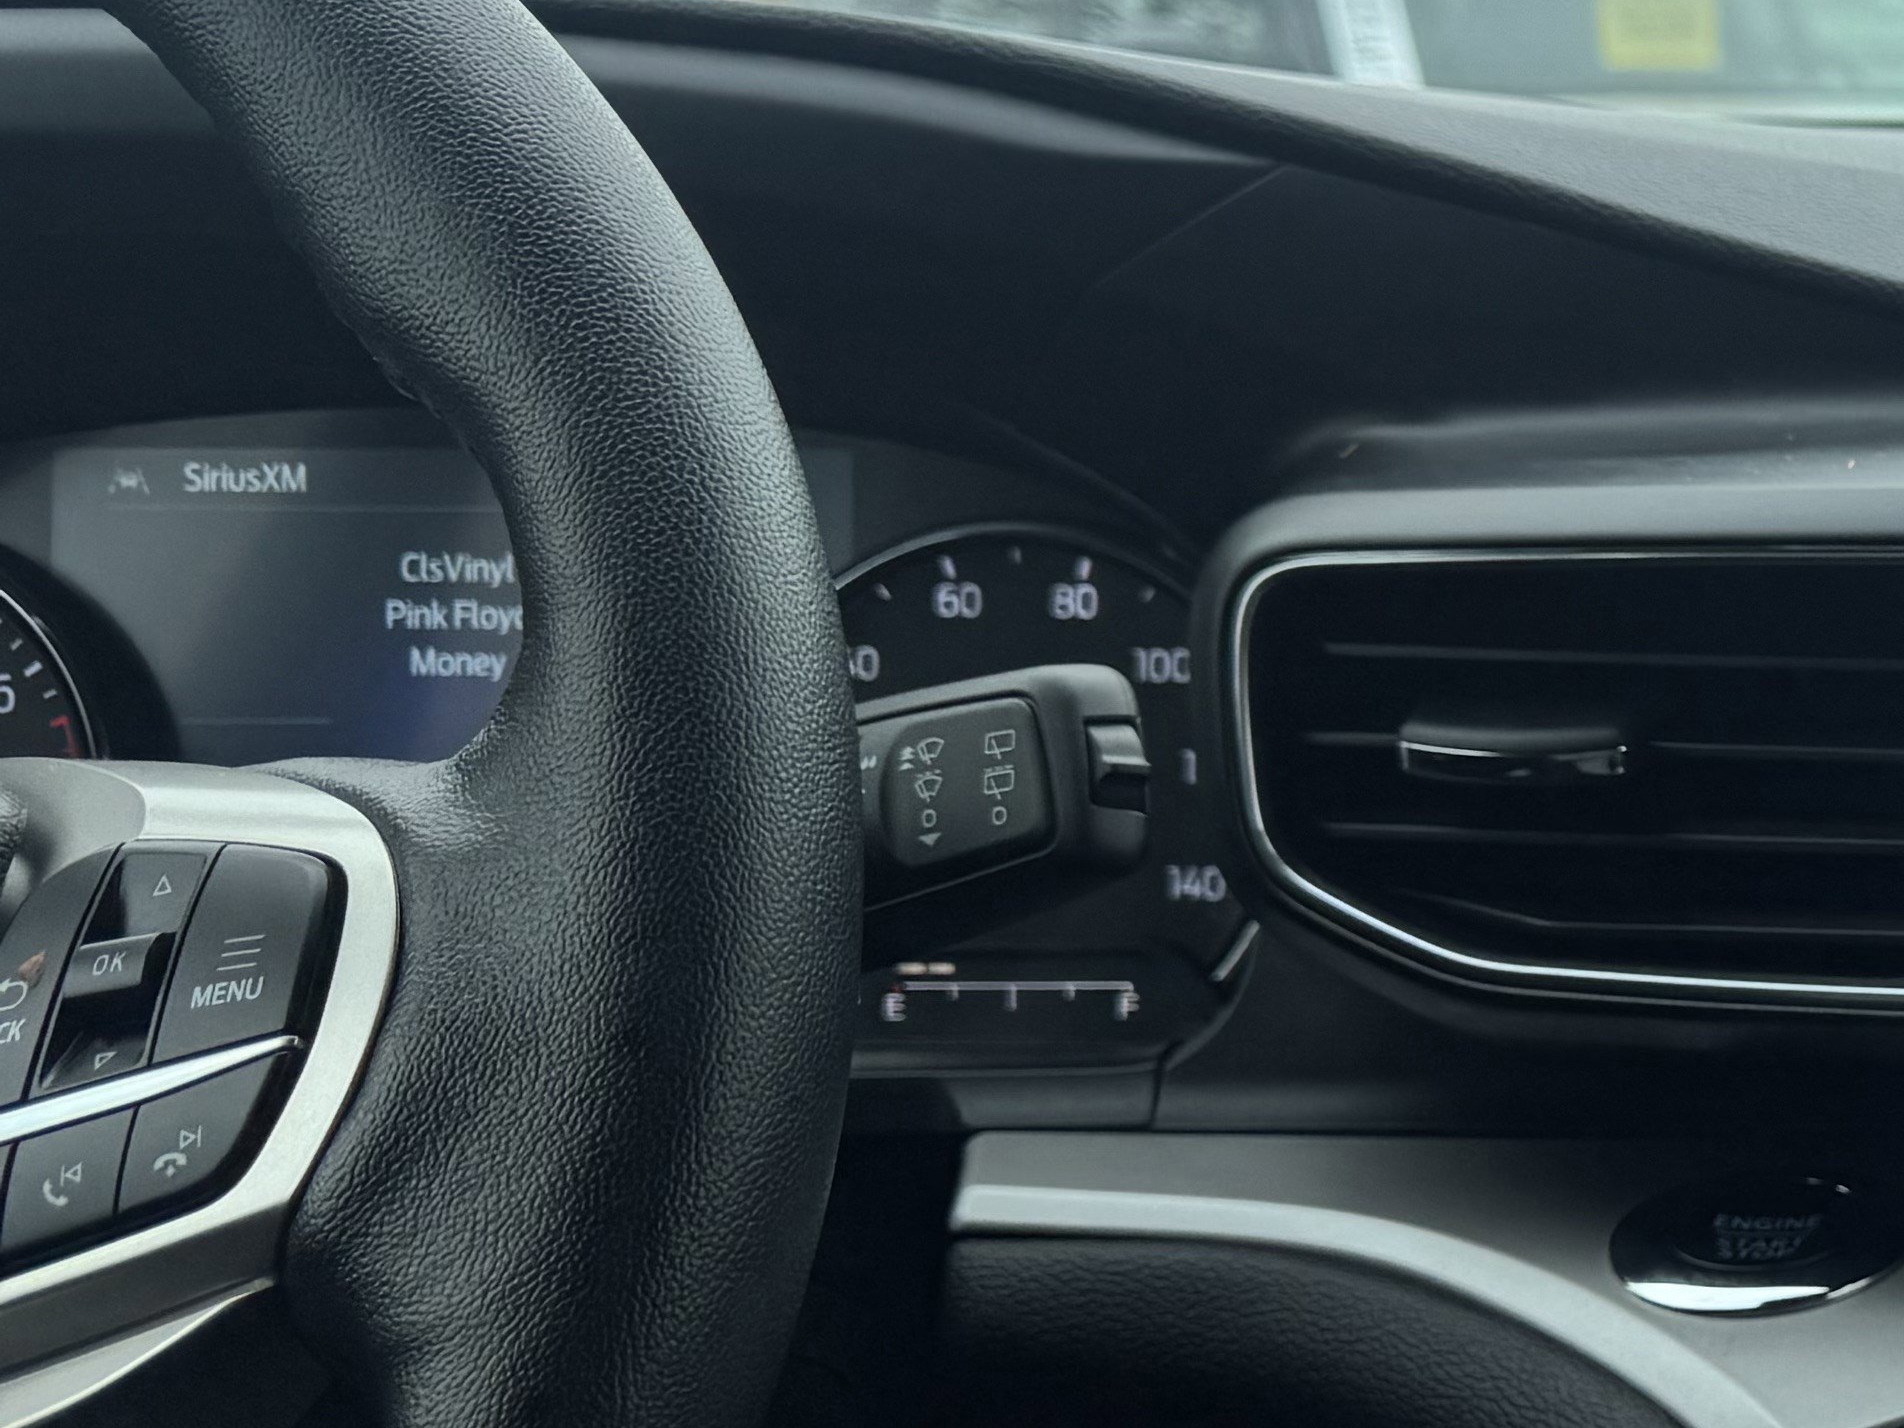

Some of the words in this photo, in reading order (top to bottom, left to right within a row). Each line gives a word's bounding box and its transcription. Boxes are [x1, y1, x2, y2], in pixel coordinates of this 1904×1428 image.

[183, 462, 306, 493] SiriusXM
[401, 551, 516, 588] ClsVinyl
[385, 597, 448, 630] Pink
[933, 582, 982, 619] 60
[1049, 582, 1099, 620] 80
[409, 645, 507, 682] Money
[848, 645, 880, 682] 0
[1165, 864, 1227, 902] 140
[92, 951, 127, 976] OK
[190, 976, 264, 1010] MENU
[881, 992, 907, 1022] E
[1115, 992, 1140, 1021] F
